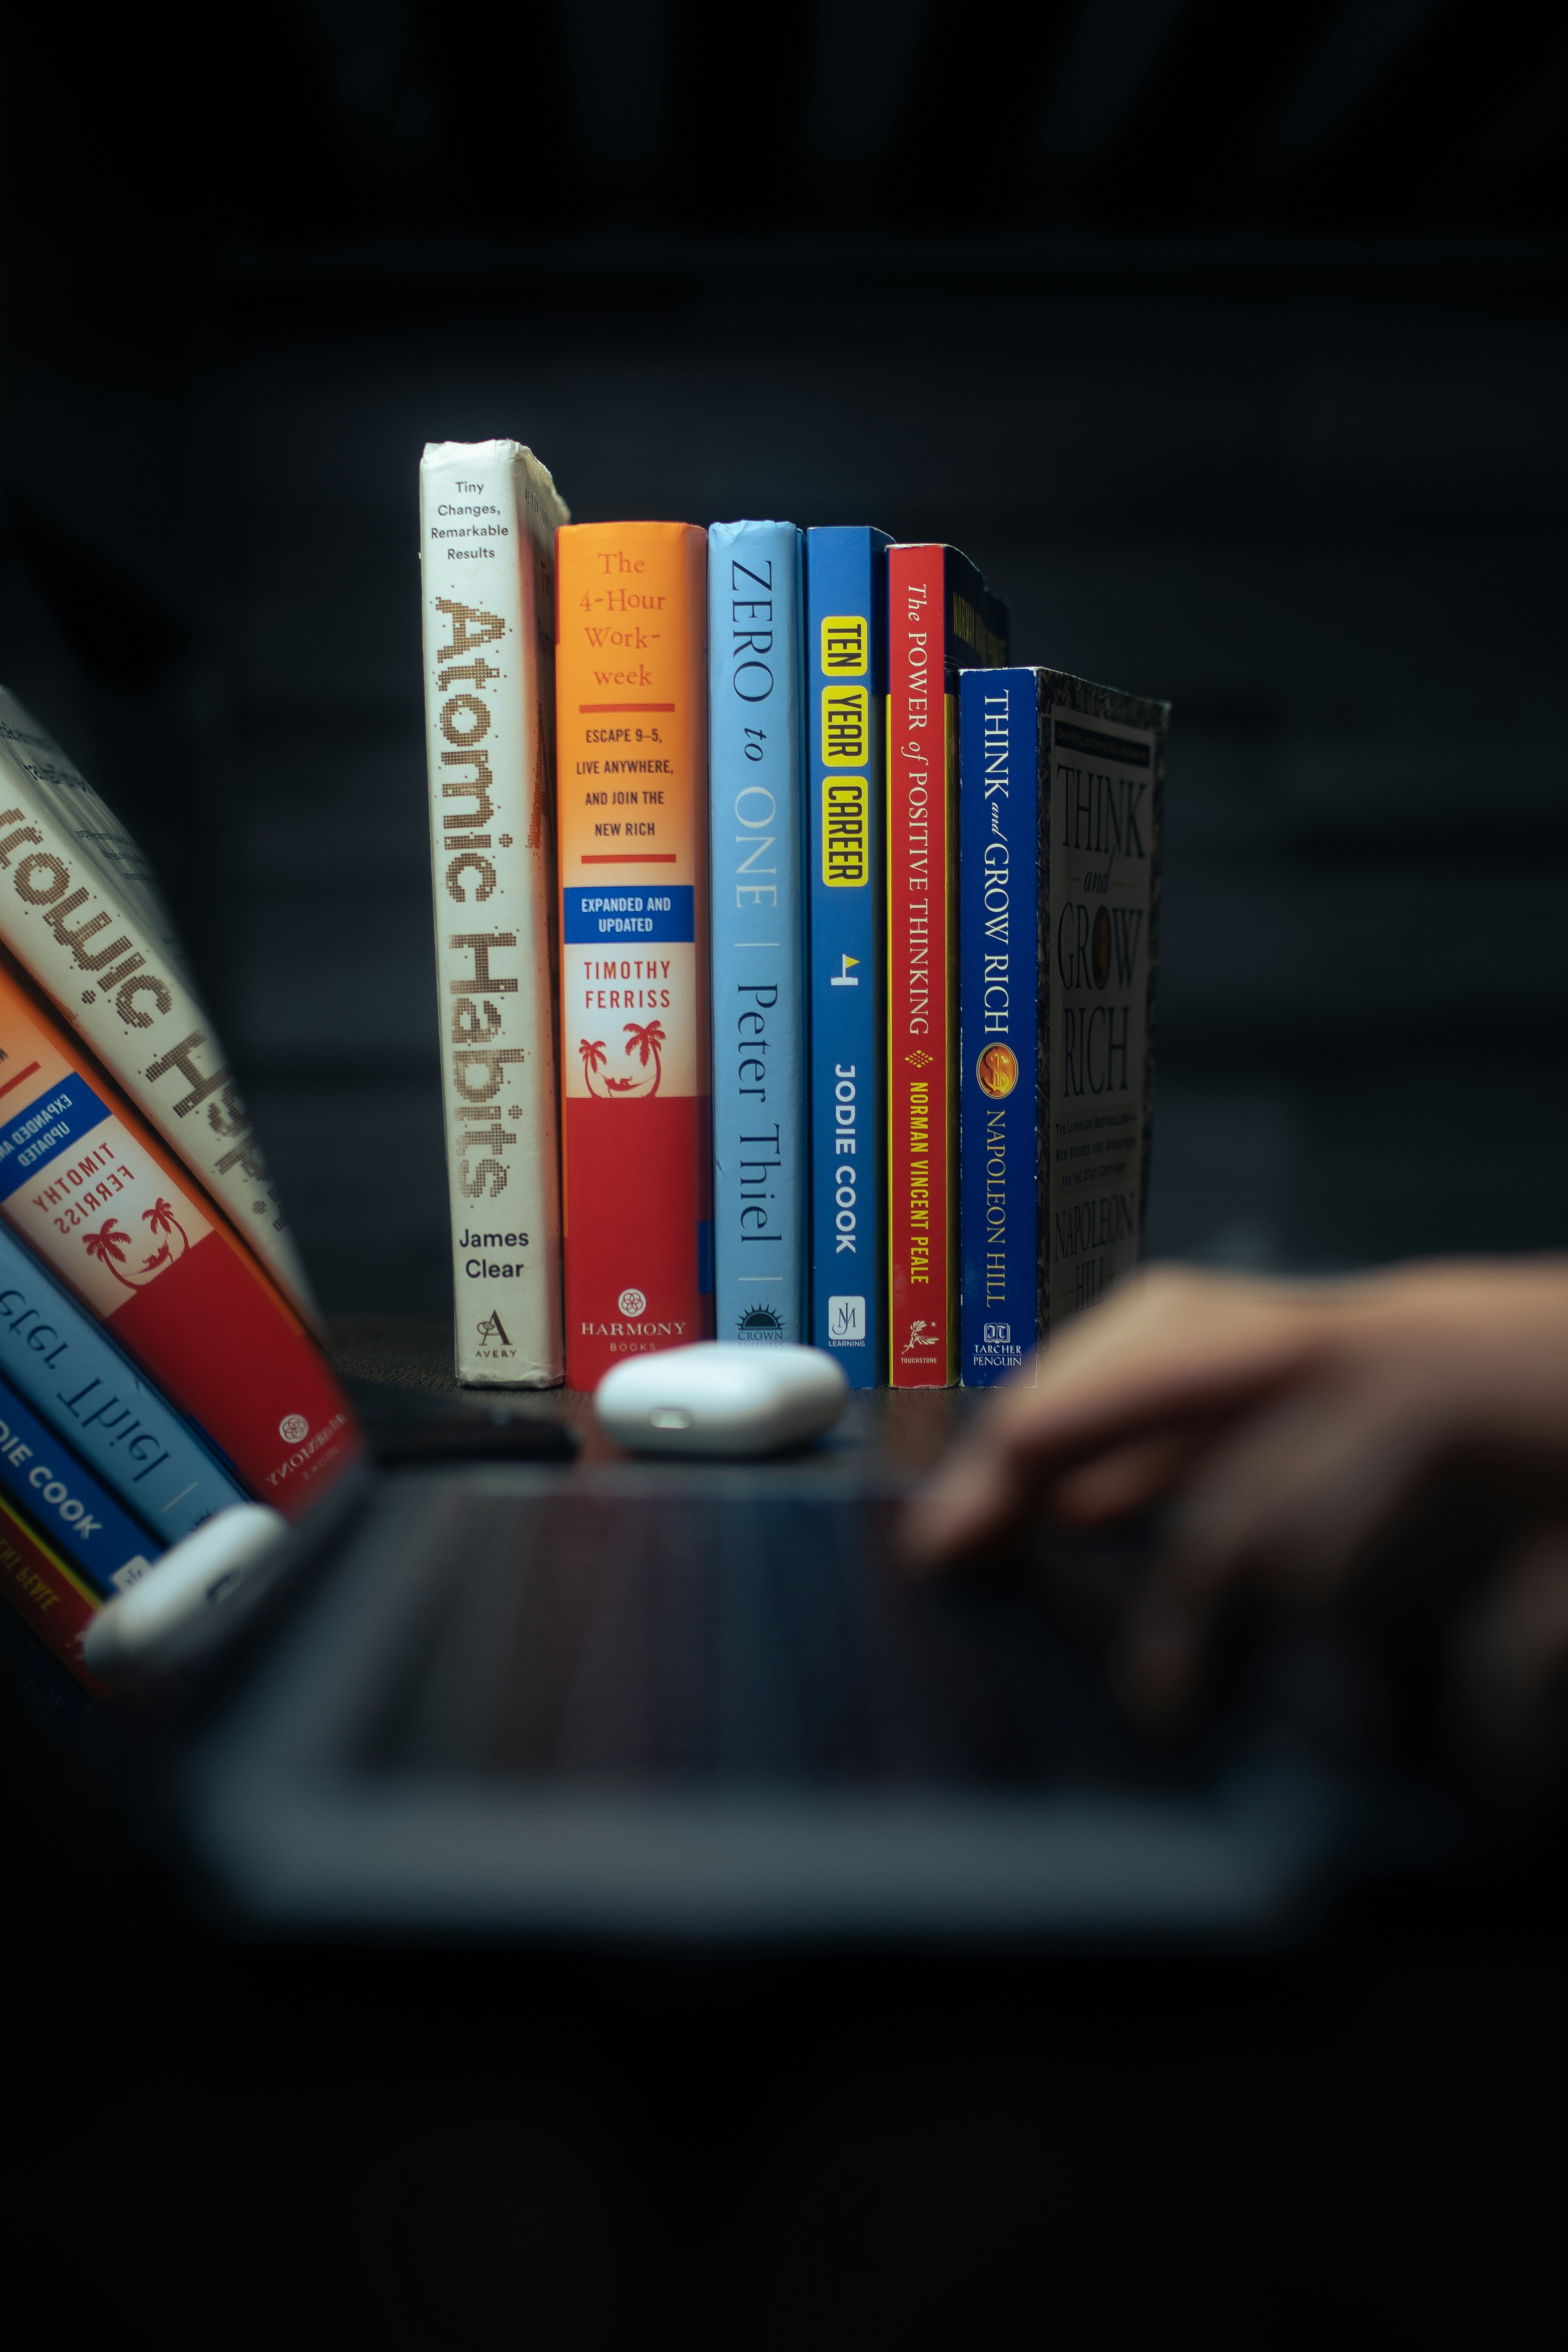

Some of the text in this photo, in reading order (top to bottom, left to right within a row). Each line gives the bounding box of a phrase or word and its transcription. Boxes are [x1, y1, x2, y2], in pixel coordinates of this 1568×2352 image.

[456, 481, 484, 495] Tiny
[438, 505, 500, 517] Changes,
[431, 525, 509, 539] Remarkable
[448, 548, 495, 559] Results
[599, 551, 645, 574] The
[580, 588, 665, 613] 4-Hour
[584, 627, 660, 648] Work-
[593, 664, 653, 686] week
[586, 729, 631, 743] ESCAPE
[732, 560, 776, 908] ZERO to ONE
[985, 689, 1009, 799] THINK
[828, 624, 862, 880] TEN YEAR CAREER
[577, 759, 673, 775] LIVE ANYWHERE,
[586, 791, 664, 805] AND JOIN THE
[901, 584, 929, 1034] The POWER of POSITIVE THINKING
[1057, 762, 1146, 859] THINK
[595, 823, 655, 836] NEW RICH
[992, 802, 1007, 841] and
[436, 597, 524, 1198] Atomic Habits
[984, 843, 1009, 945] GROW
[582, 898, 670, 912] EXPANDED AND
[599, 918, 653, 932] UPDATED
[1058, 902, 1143, 990] GROW
[584, 961, 670, 979] TIMOTHY
[586, 990, 670, 1008] FERRISS
[984, 954, 1009, 1034] RICH
[1064, 1006, 1130, 1098] RICH
[738, 984, 782, 1241] Peter Thiel
[835, 1064, 856, 1253] JODIE COOK
[910, 1083, 929, 1283] NORMAN VINCENT PEALE
[987, 1110, 1005, 1307] NAPOLEON HILL
[1055, 1193, 1134, 1261] NAPOLEON
[460, 1229, 529, 1248] James
[466, 1259, 524, 1278] Clear
[582, 1322, 686, 1335] HARMONY
[738, 1332, 783, 1341] CROWN
[476, 1350, 516, 1358] AVERY
[610, 1343, 656, 1351] BOOKS
[974, 1345, 1021, 1354] TARCHER
[974, 1357, 1021, 1366] PENGUIN
